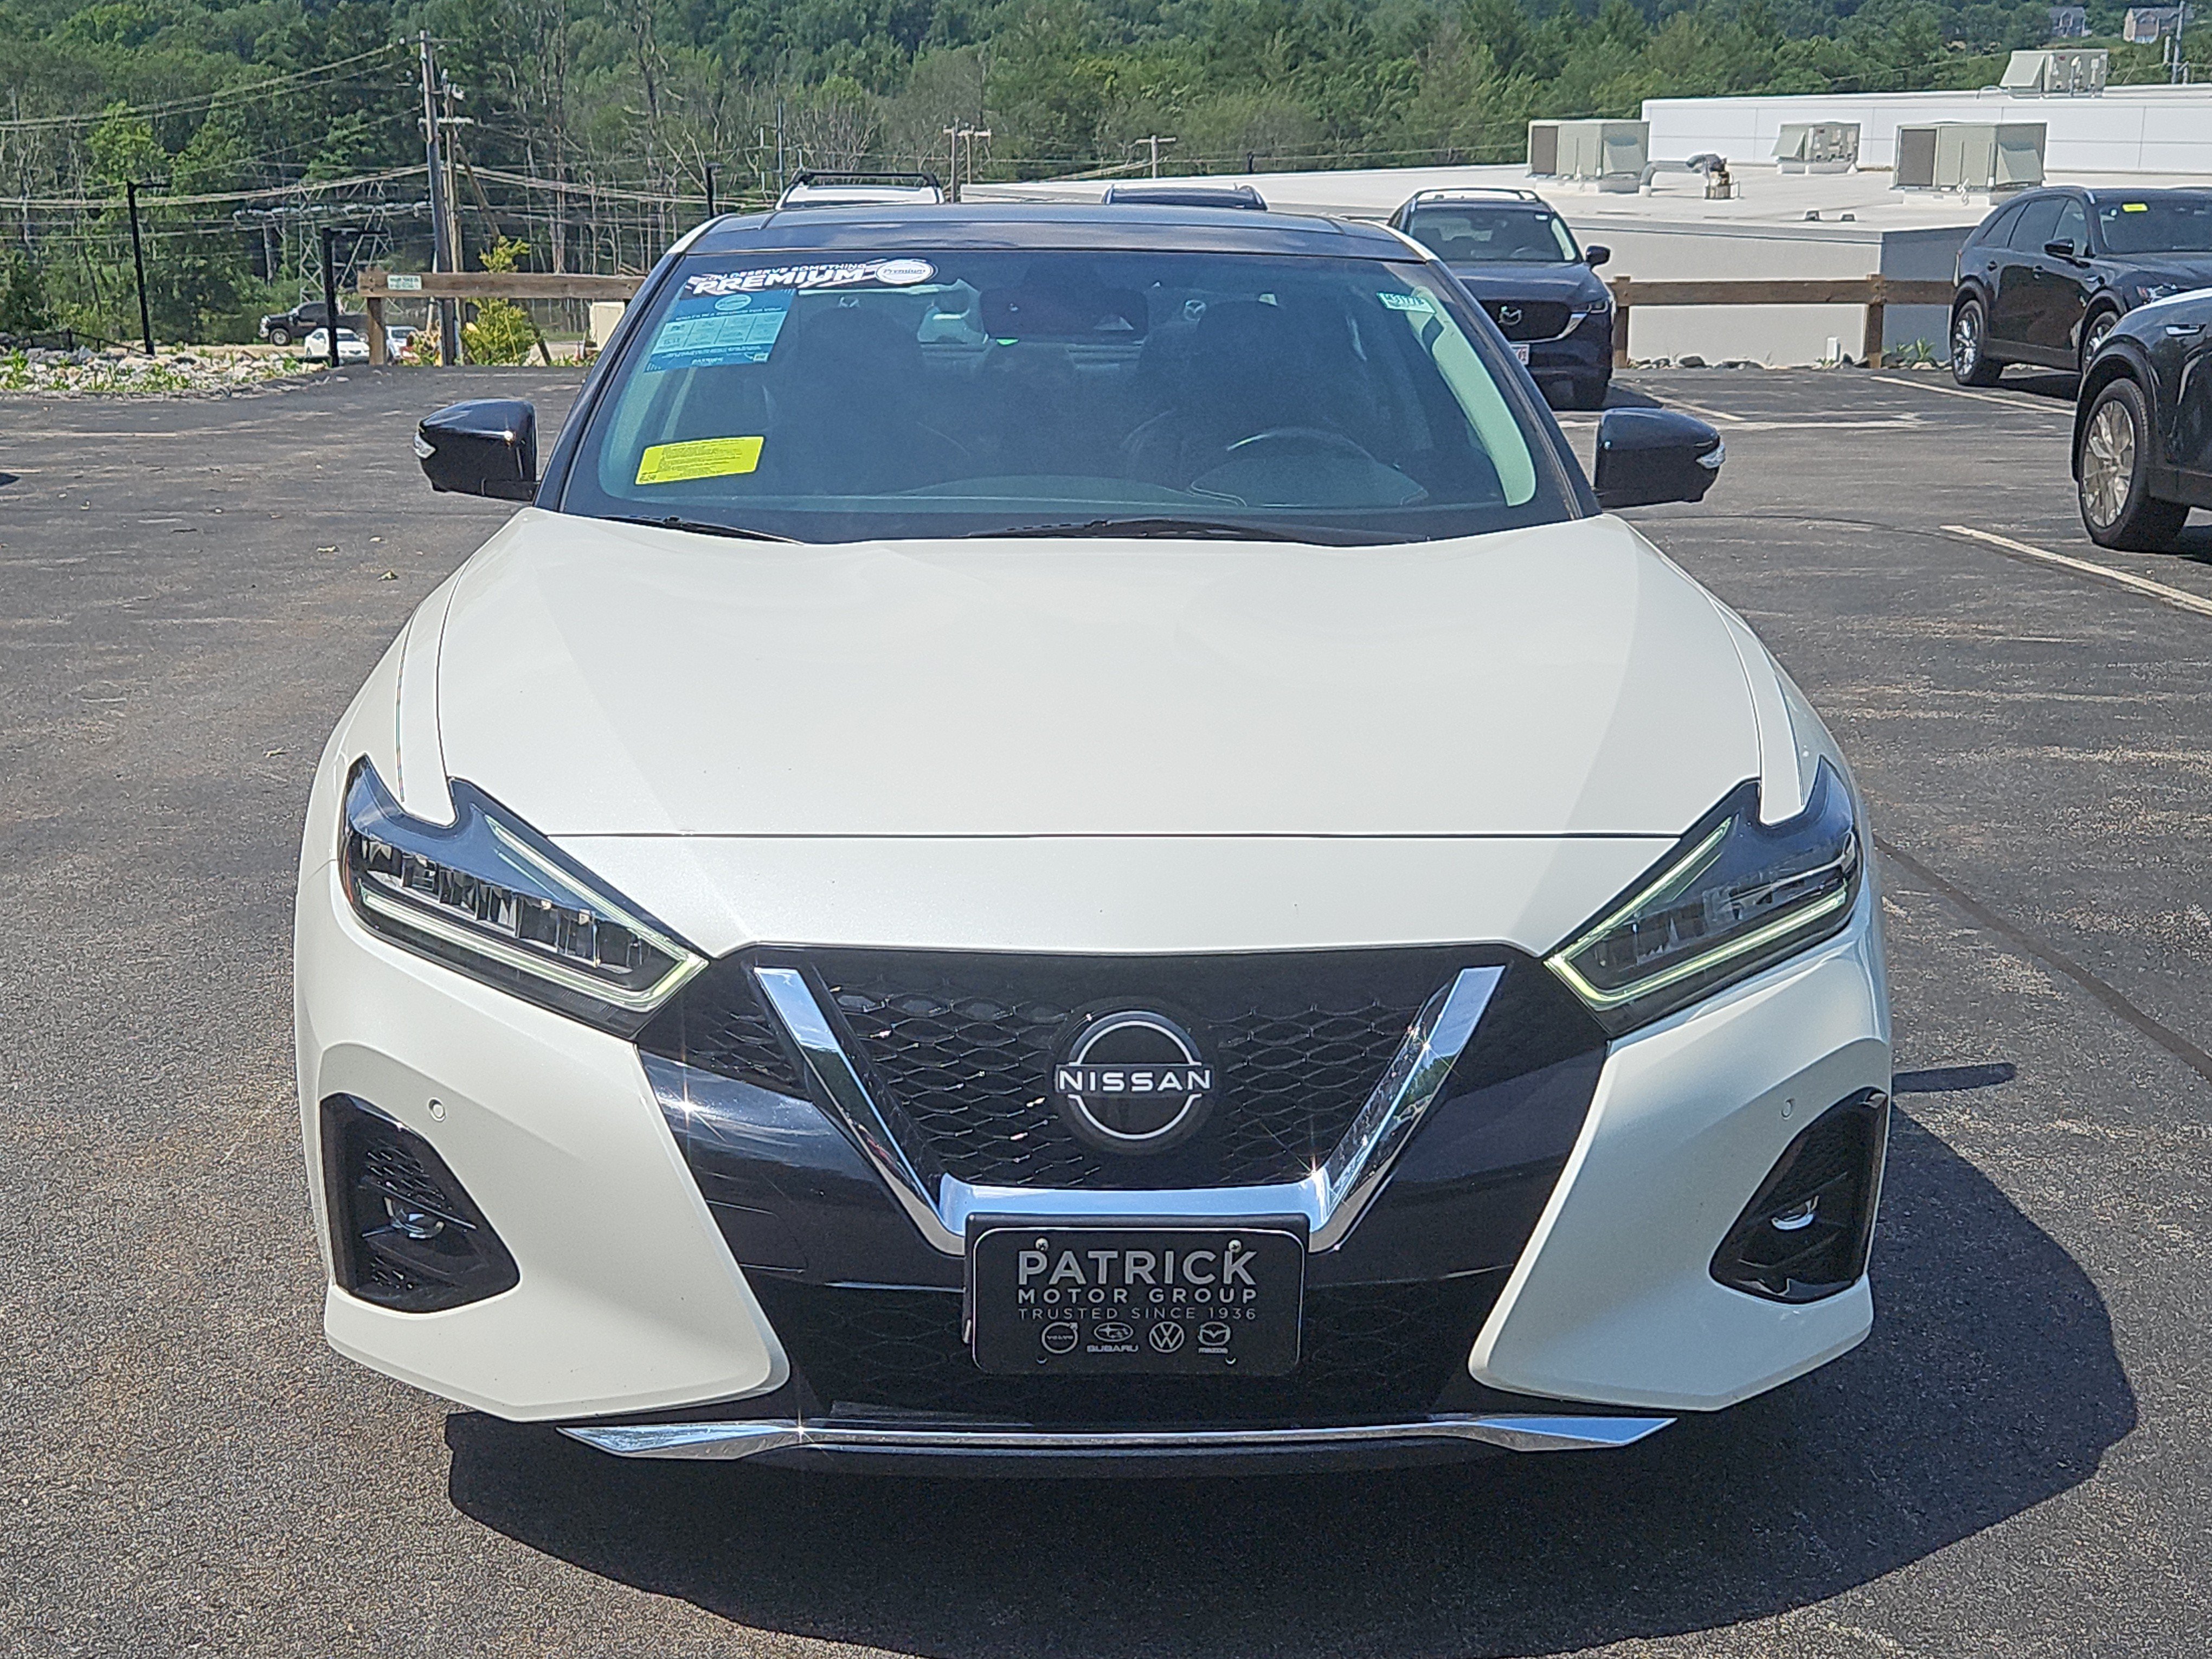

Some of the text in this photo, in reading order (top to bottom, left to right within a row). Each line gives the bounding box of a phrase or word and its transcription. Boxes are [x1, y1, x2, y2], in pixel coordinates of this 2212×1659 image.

[692, 269, 865, 294] PREMIUM
[1059, 1070, 1210, 1091] NISSAN
[1018, 1251, 1257, 1285] PATRICK
[1018, 1288, 1257, 1304] MOTOR GROUP
[1018, 1307, 1256, 1320] TRUSTED SINCE 1936
